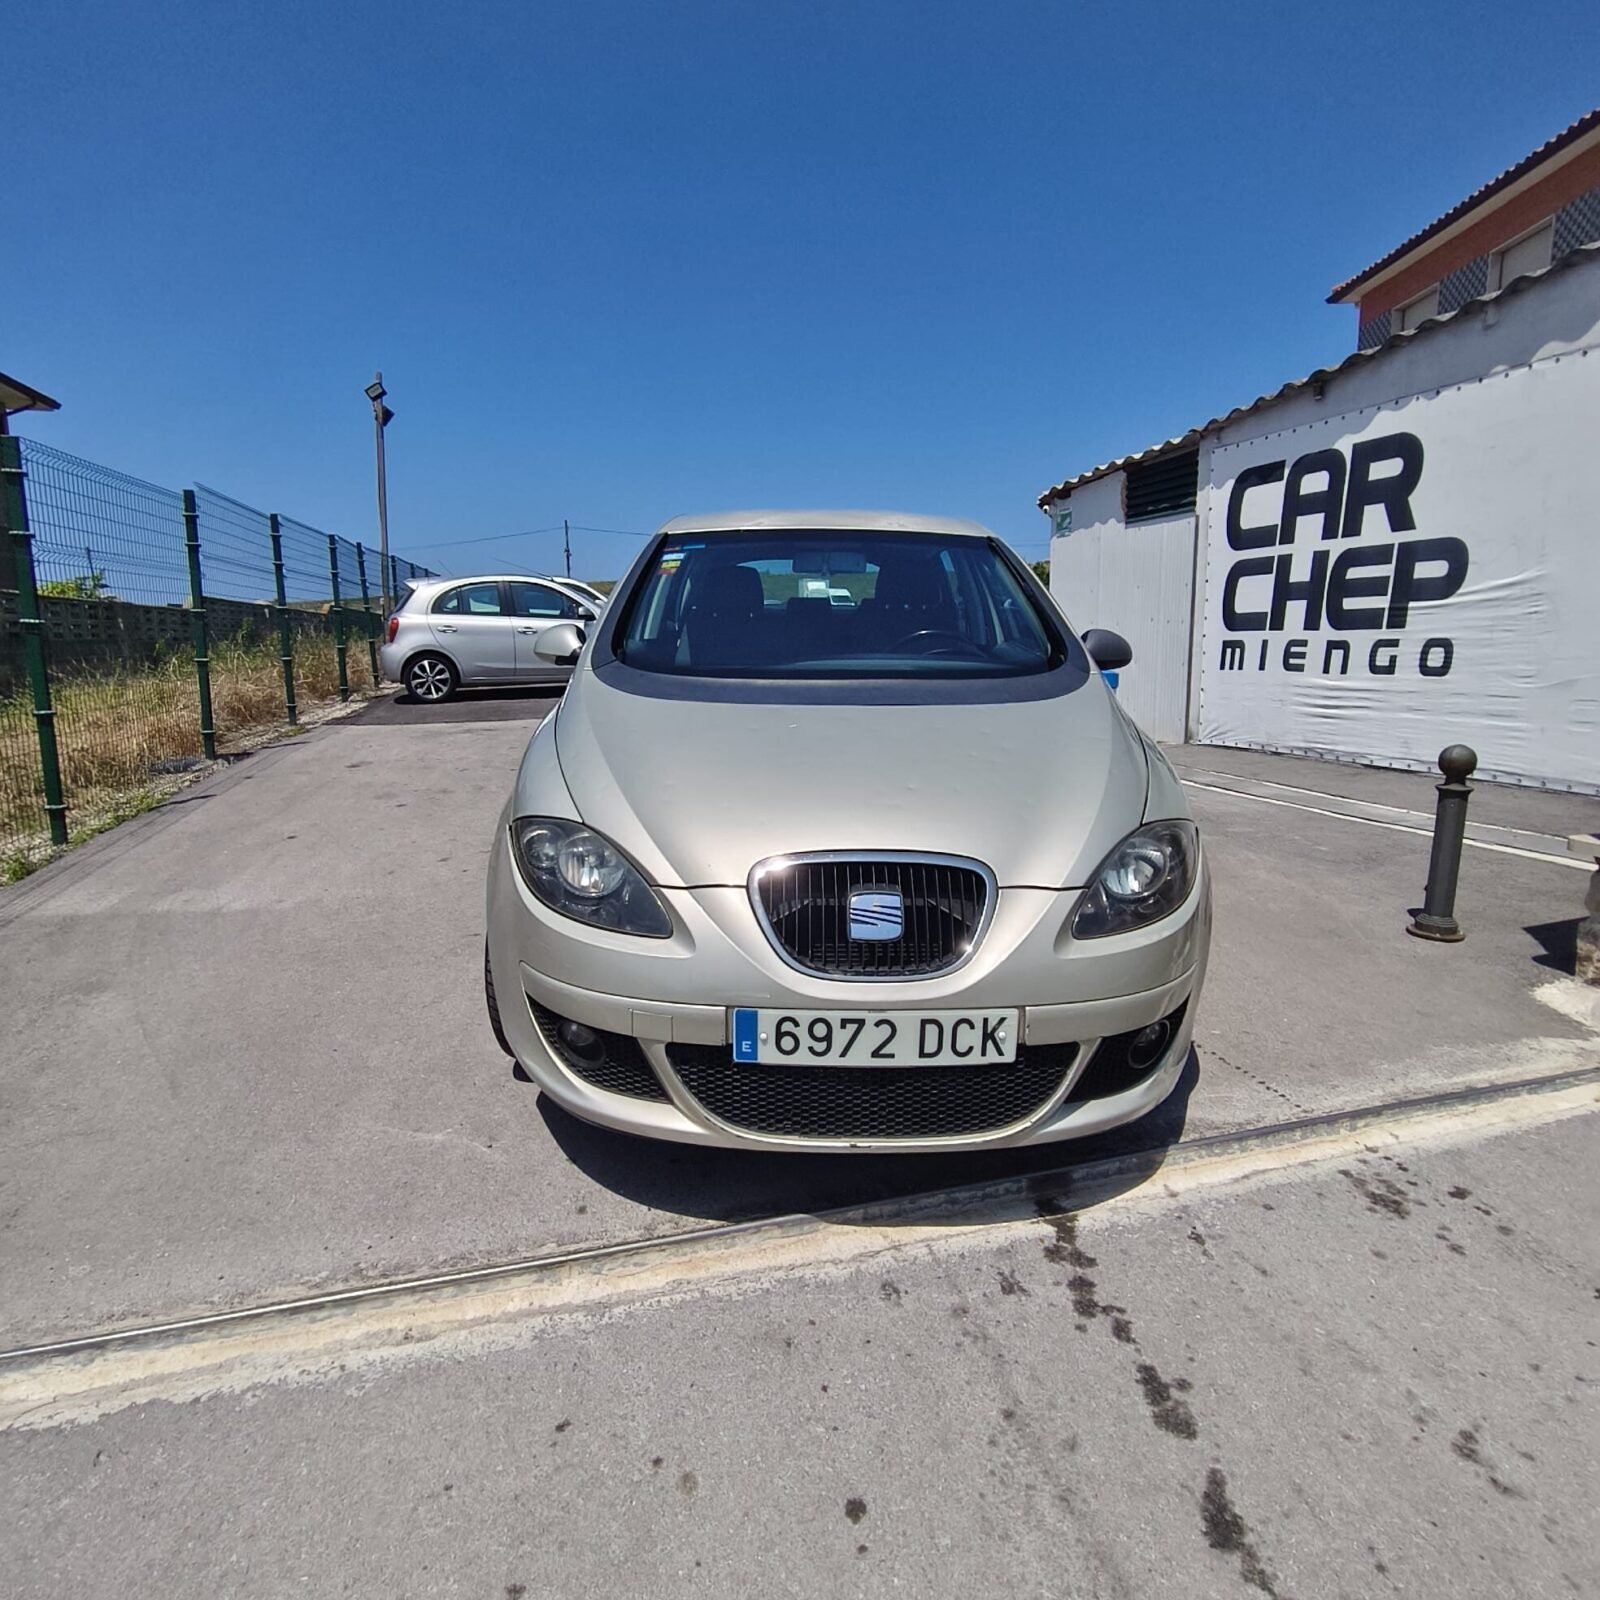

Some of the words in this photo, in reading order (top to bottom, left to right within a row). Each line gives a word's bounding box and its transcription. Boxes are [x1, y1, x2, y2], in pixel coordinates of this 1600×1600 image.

[1226, 432, 1424, 551] CAR
[1222, 537, 1469, 631] CHEP
[1220, 638, 1454, 677] MIENGO
[742, 1041, 752, 1052] E
[774, 1016, 898, 1059] 6972
[918, 1017, 1008, 1059] DCK
